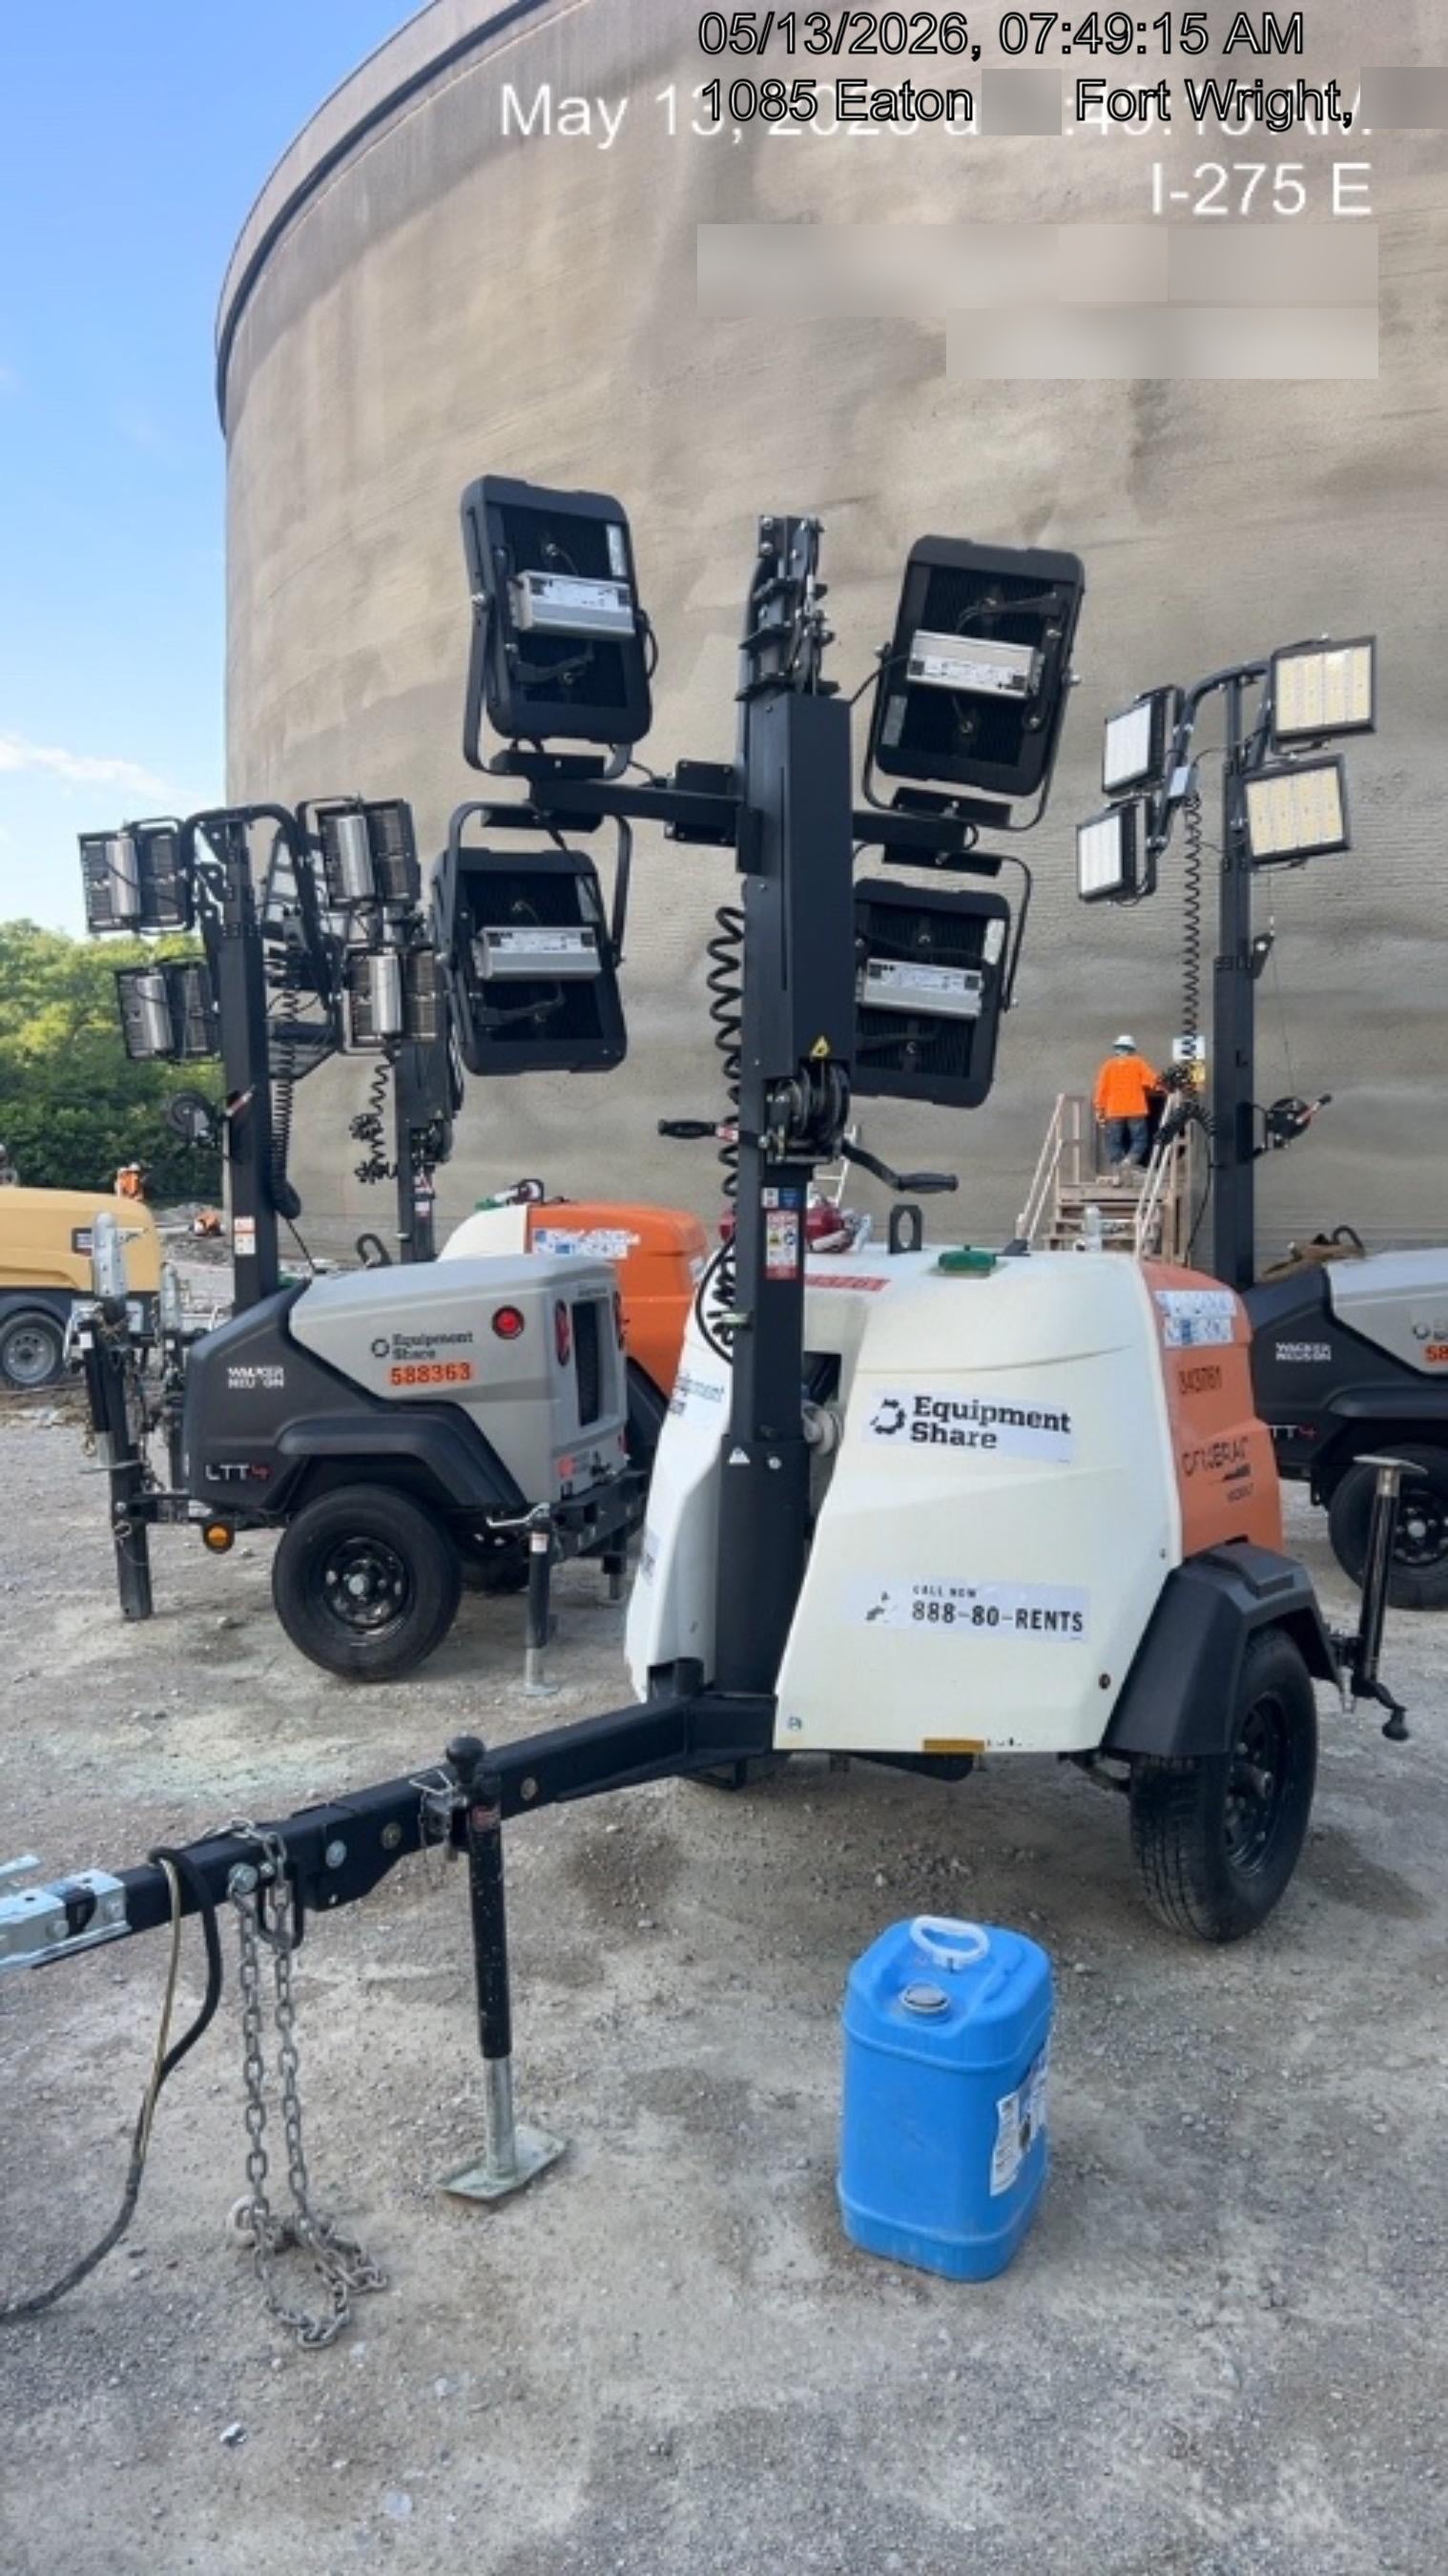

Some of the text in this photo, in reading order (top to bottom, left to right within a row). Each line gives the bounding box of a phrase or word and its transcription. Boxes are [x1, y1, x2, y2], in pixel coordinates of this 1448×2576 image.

[392, 1332, 473, 1347] Equipment
[391, 1362, 471, 1385] 588363
[228, 1378, 284, 1389] NEUON
[913, 1396, 1071, 1433] Equipment
[911, 1422, 998, 1448] Share
[204, 1465, 271, 1481] LTT4
[913, 1585, 943, 1597] CALL
[912, 1600, 1085, 1633] 888-80-RENTS
